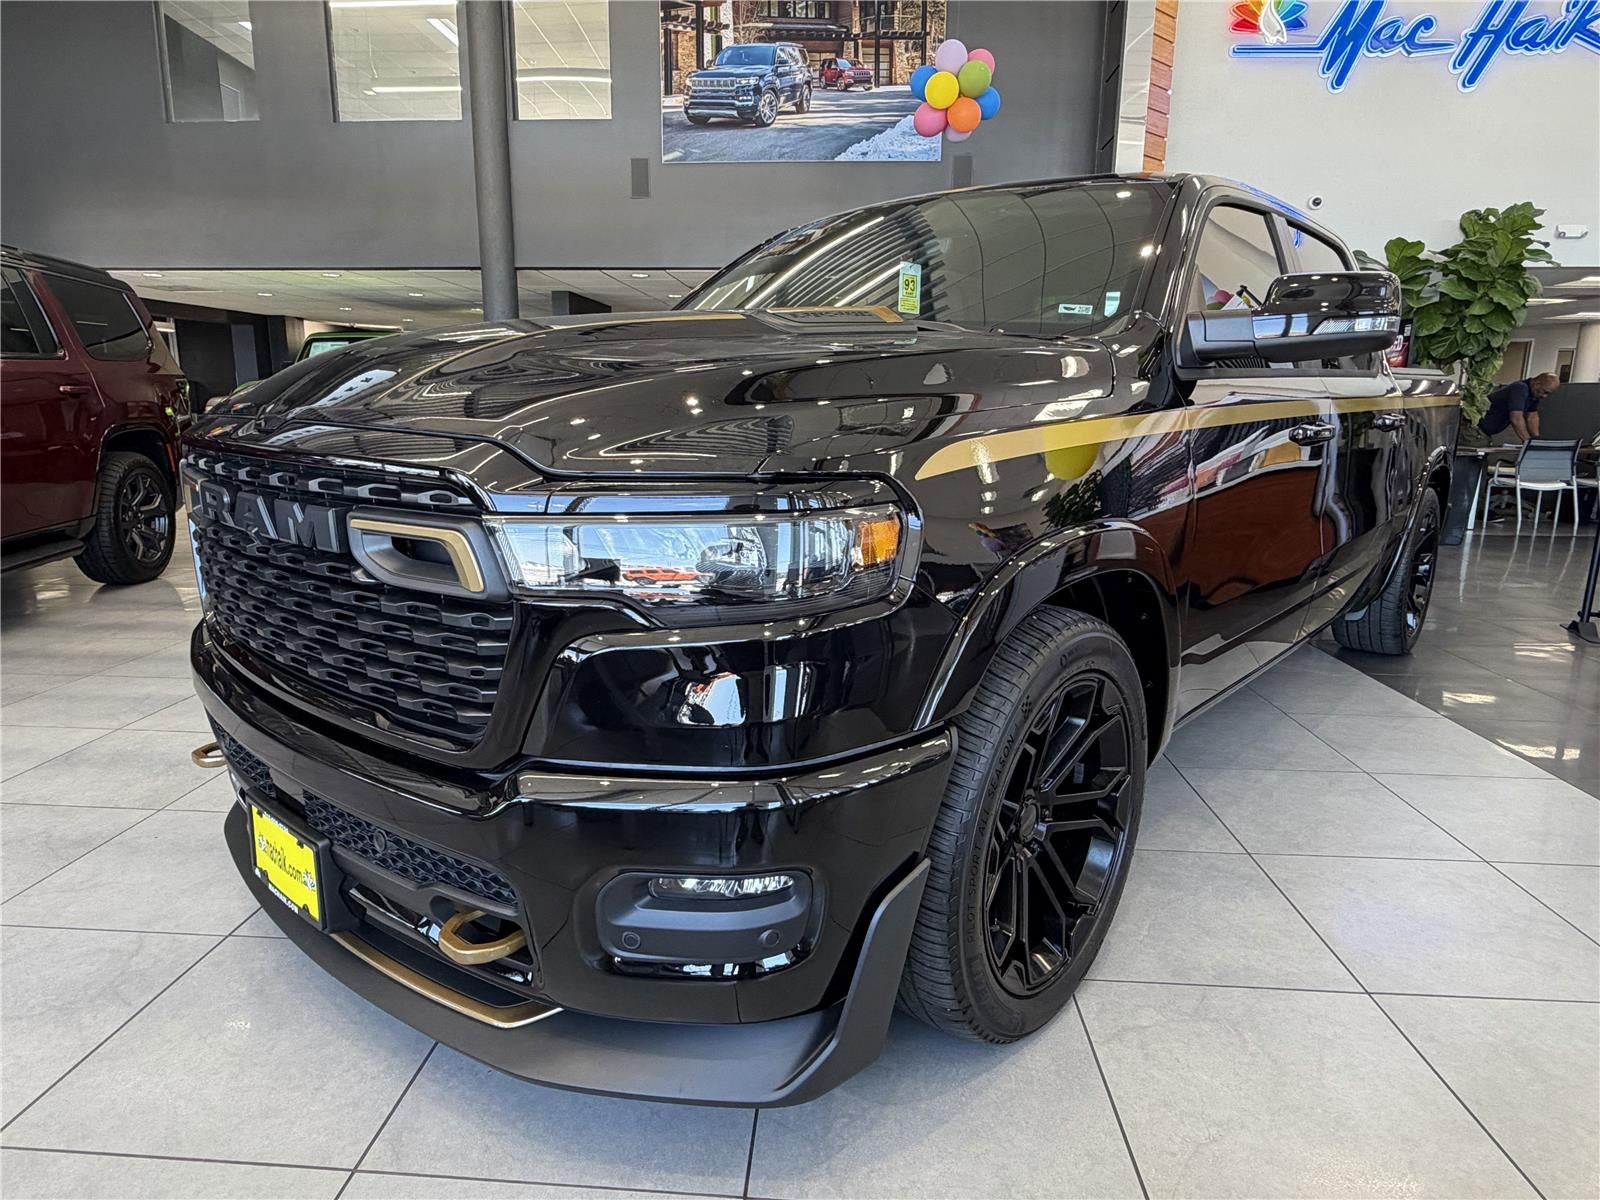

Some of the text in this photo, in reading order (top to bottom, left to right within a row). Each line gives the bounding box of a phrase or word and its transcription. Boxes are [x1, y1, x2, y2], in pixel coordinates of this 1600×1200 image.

[1312, 0, 1600, 93] Mac Haik
[904, 279, 916, 292] 93
[200, 479, 341, 553] RAM
[966, 734, 1015, 944] PILOT SPORT ALL SEASON
